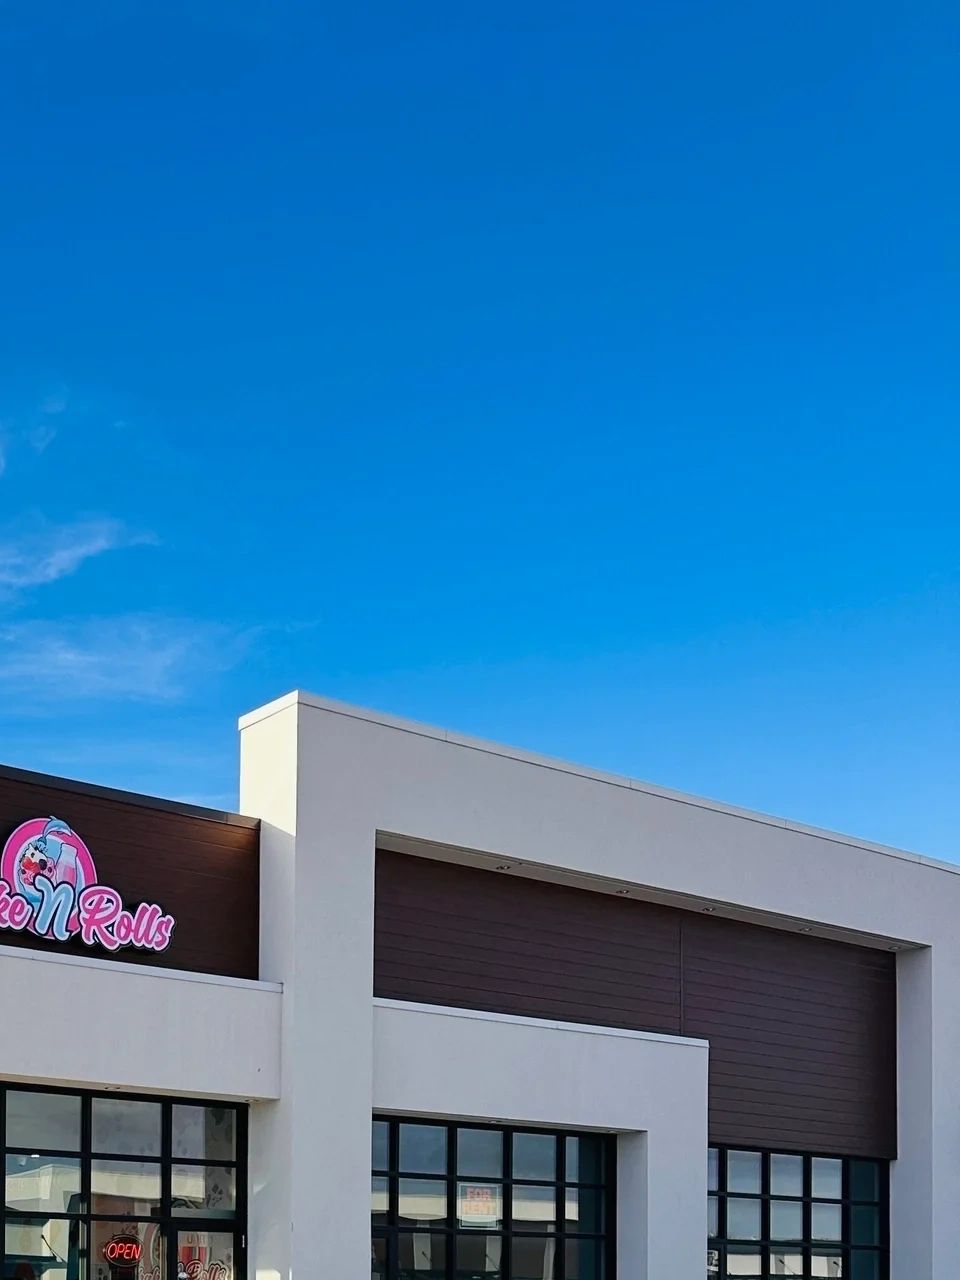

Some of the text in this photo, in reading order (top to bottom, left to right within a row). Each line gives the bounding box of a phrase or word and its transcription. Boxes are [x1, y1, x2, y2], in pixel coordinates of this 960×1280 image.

[33, 875, 74, 941] N
[79, 885, 175, 950] Rolls
[466, 1187, 491, 1200] FOR
[107, 1243, 142, 1259] OPEN
